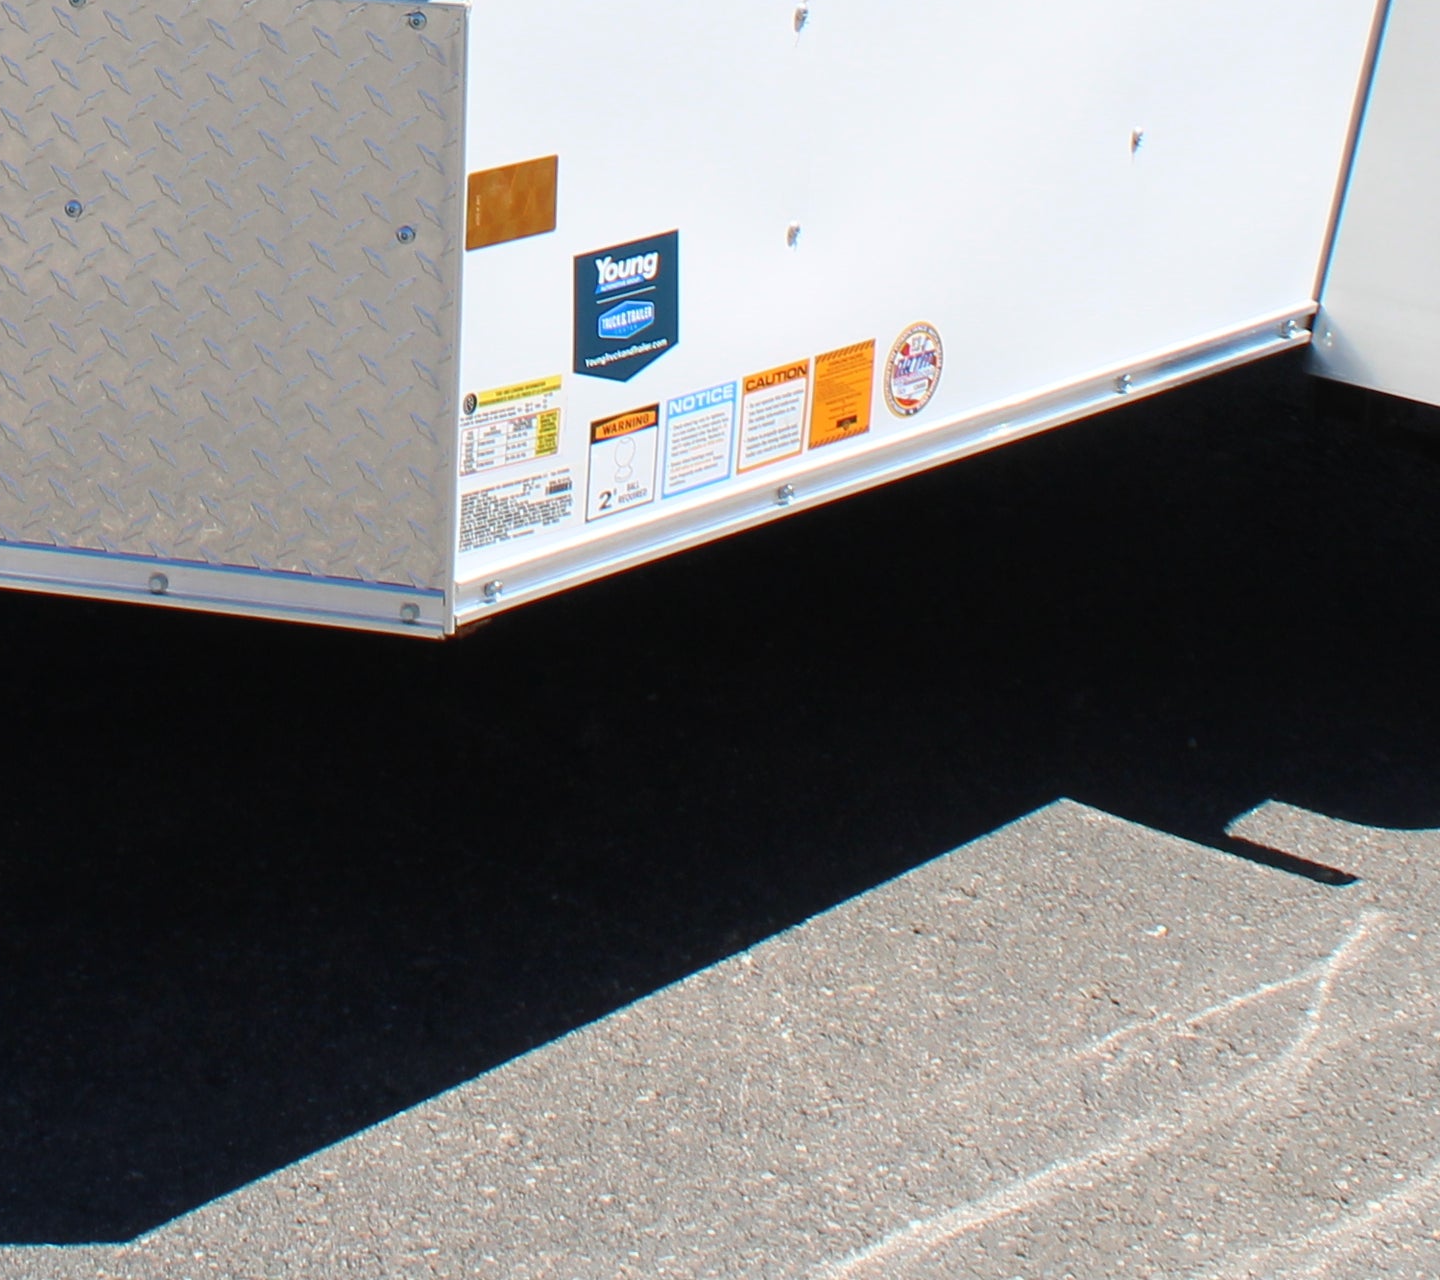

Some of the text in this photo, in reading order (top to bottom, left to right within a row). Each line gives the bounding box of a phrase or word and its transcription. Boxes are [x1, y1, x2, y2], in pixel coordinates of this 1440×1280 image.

[595, 252, 659, 283] Young
[627, 305, 652, 324] TRAILER
[745, 364, 808, 392] CAUTION
[669, 383, 734, 416] NOTICE
[602, 413, 650, 436] WARNING
